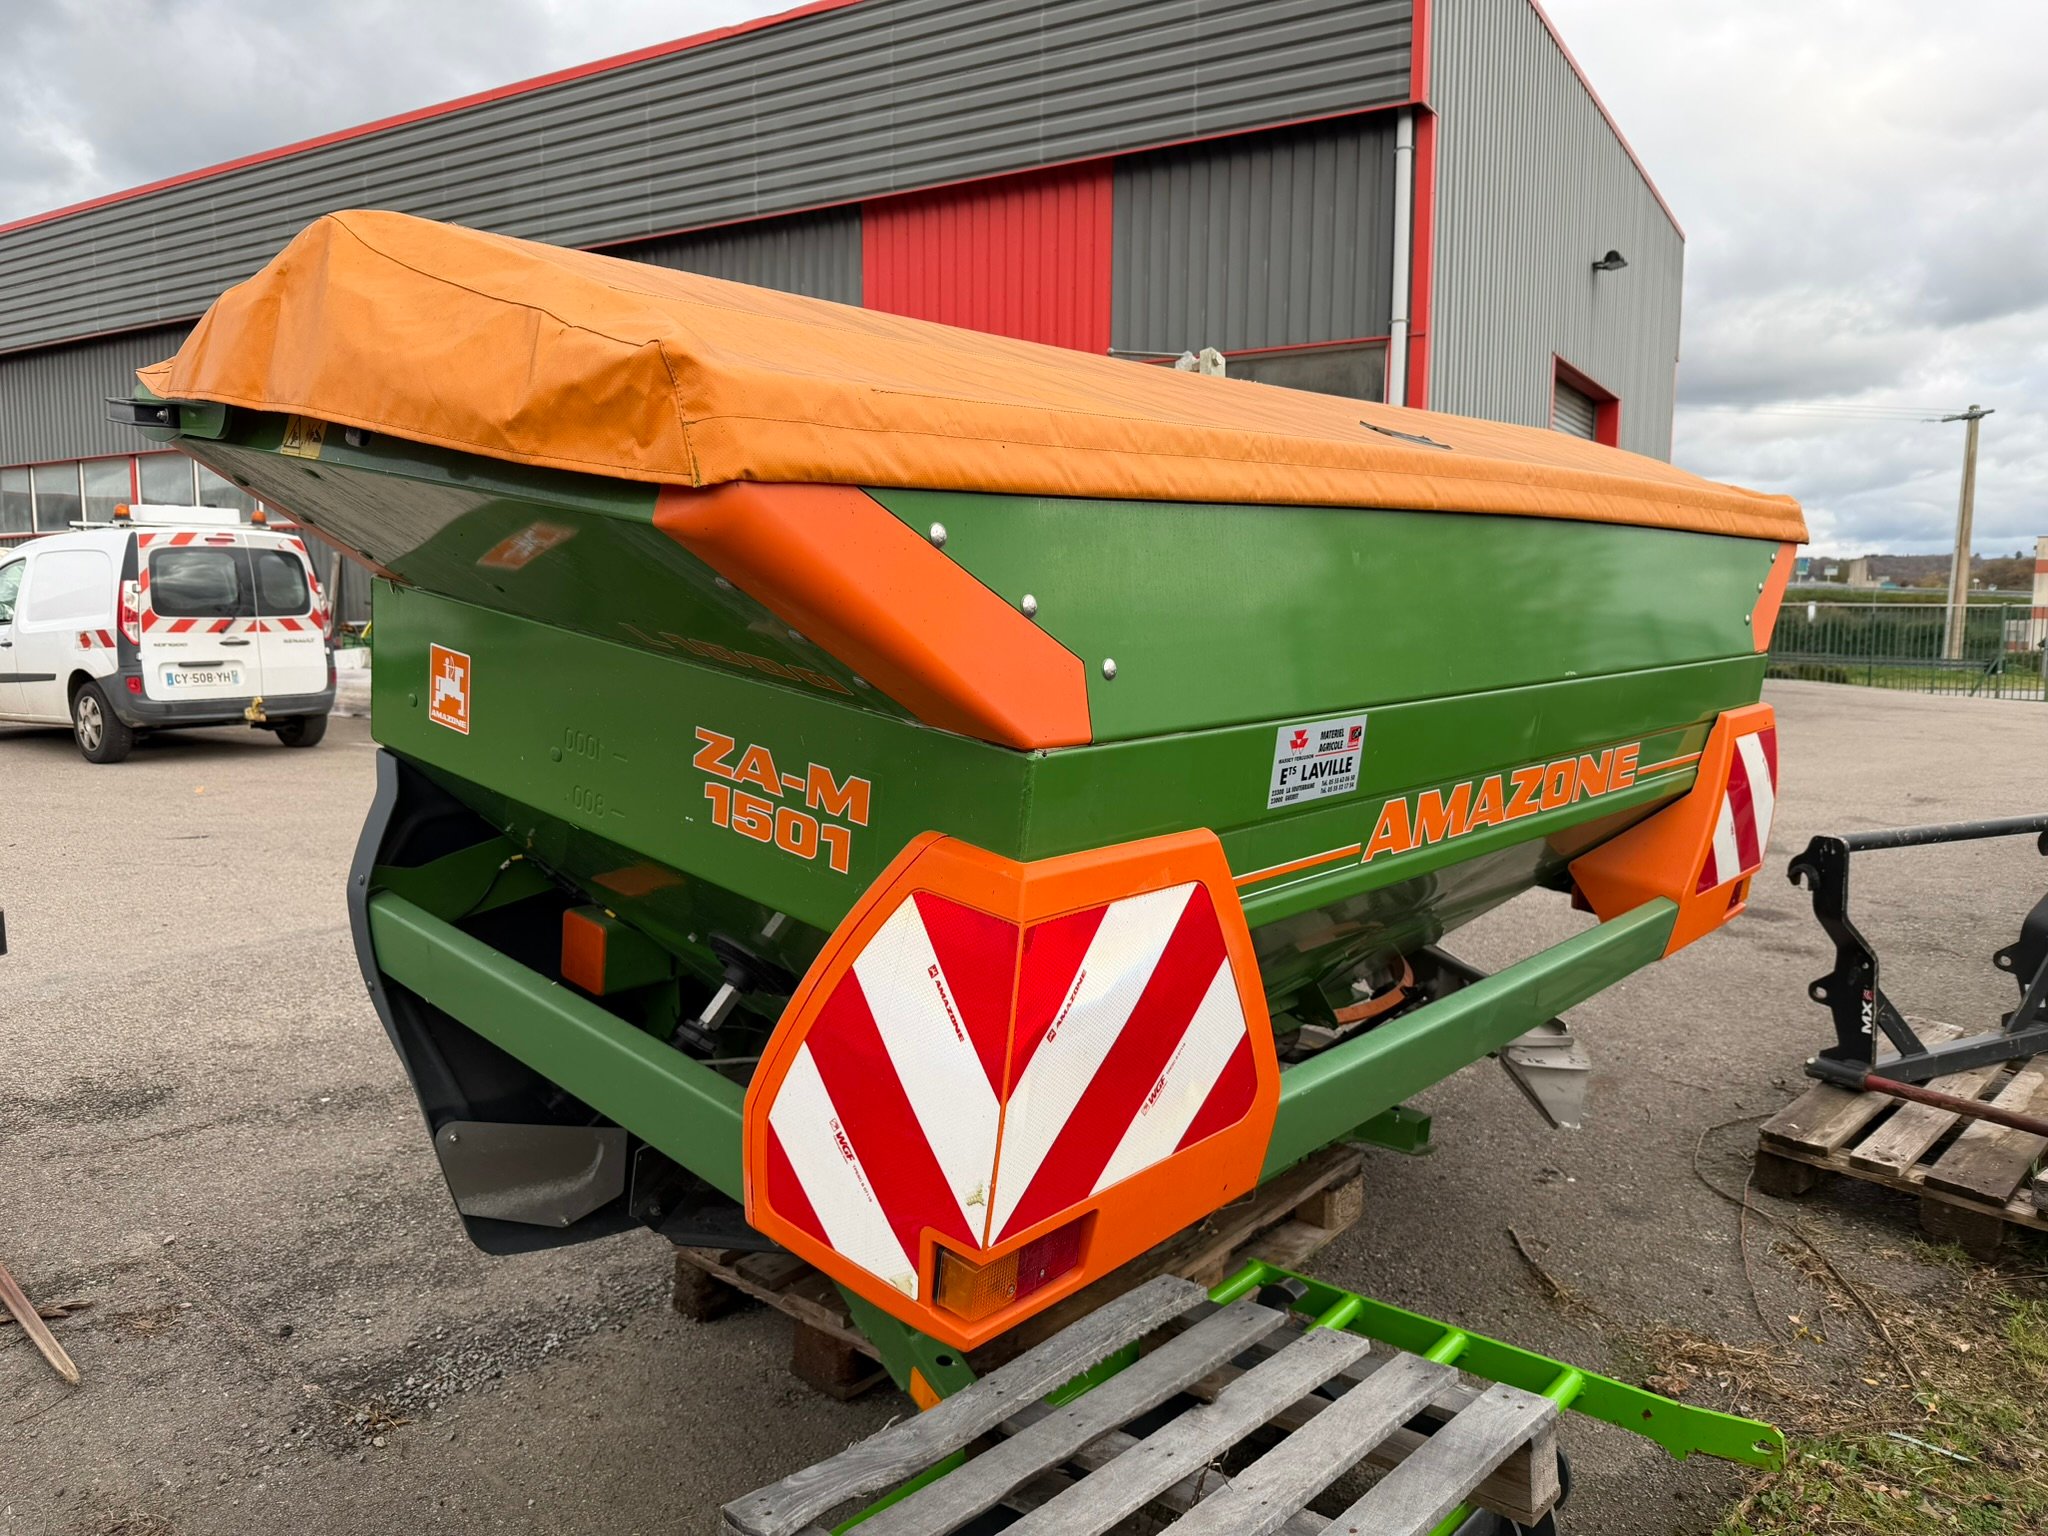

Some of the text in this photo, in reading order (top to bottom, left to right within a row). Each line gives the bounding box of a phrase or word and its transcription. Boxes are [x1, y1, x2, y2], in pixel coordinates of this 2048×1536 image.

[431, 709, 468, 728] AMAZONE
[1320, 728, 1344, 740] MATERIEL
[1318, 740, 1344, 752] AGRICOLE
[693, 726, 871, 827] ZA-M
[1301, 756, 1353, 781] LAVILLE
[1361, 742, 1640, 863] AMAZONE
[704, 781, 850, 875] 1501
[935, 980, 965, 1042] AMAZONE
[1056, 969, 1087, 1029] AMAZONE
[1861, 1000, 1873, 1034] MX
[1148, 1074, 1165, 1105] WGF
[836, 1131, 855, 1161] WGF
